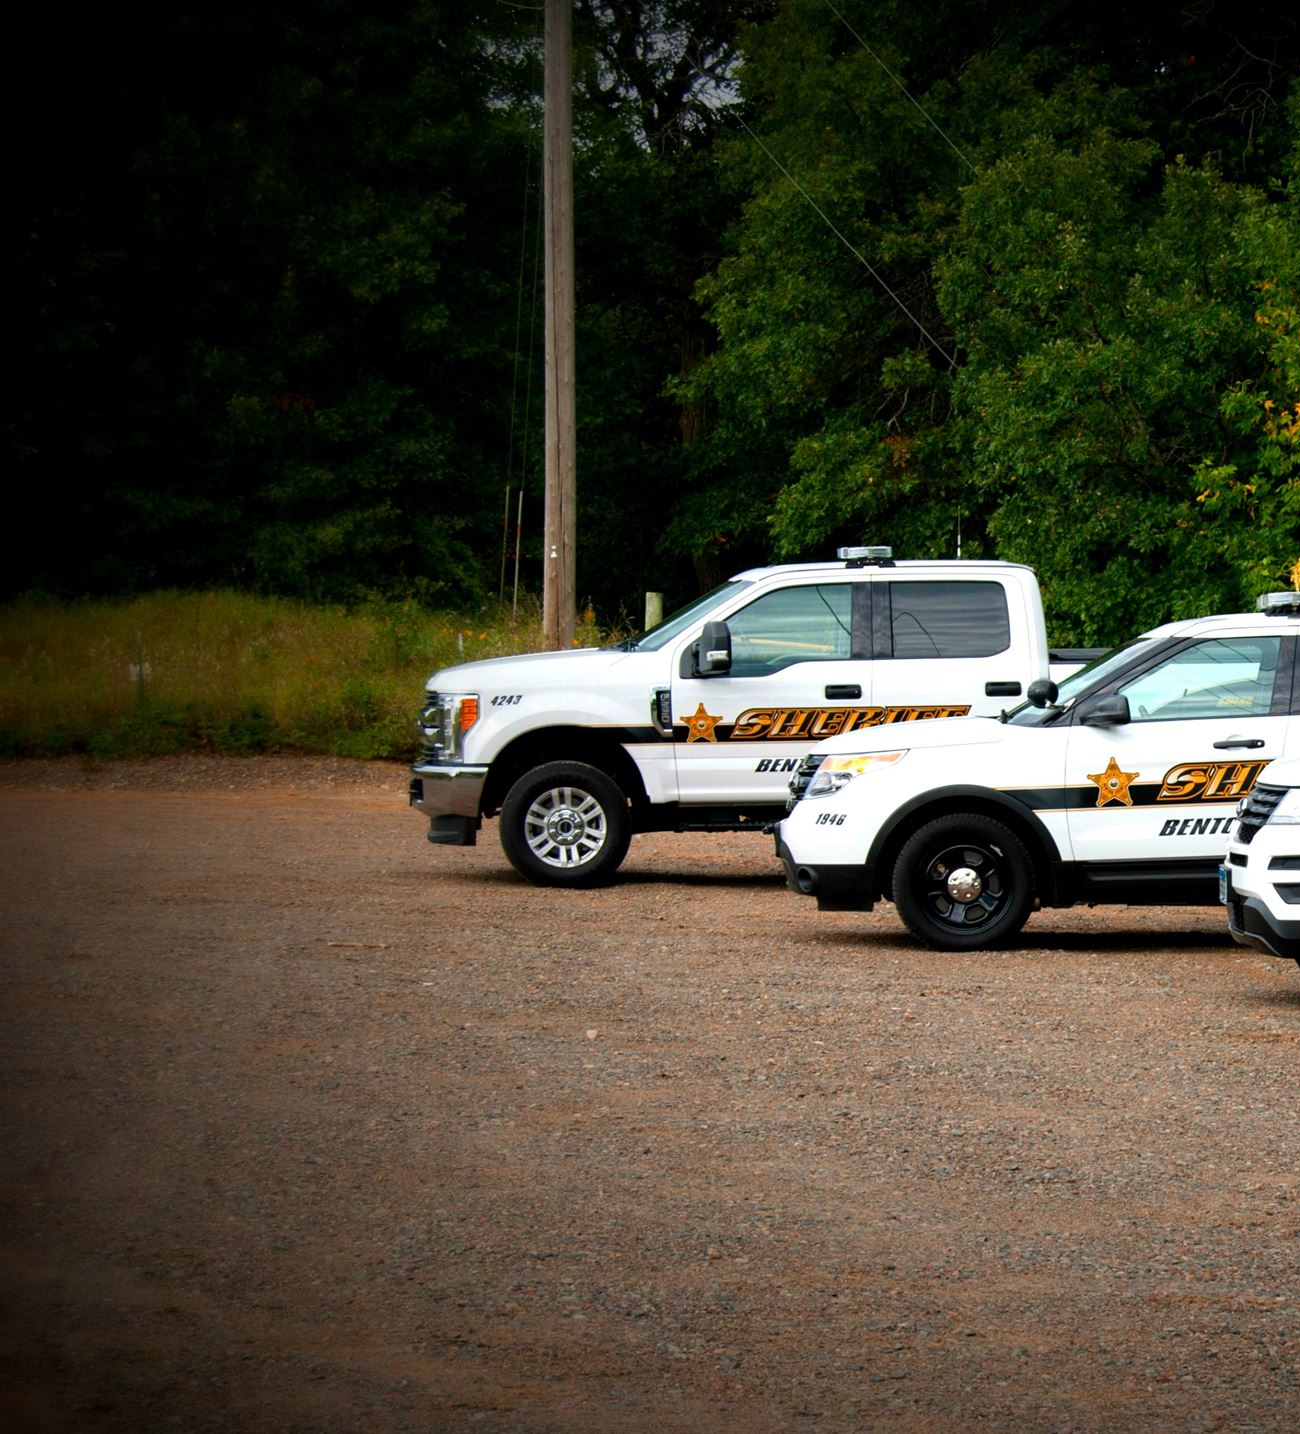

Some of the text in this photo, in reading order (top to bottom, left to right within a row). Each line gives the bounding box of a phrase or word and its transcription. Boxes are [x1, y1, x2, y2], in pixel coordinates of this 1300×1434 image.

[490, 695, 523, 706] 4243
[1157, 759, 1274, 800] SH
[815, 813, 847, 825] 1946
